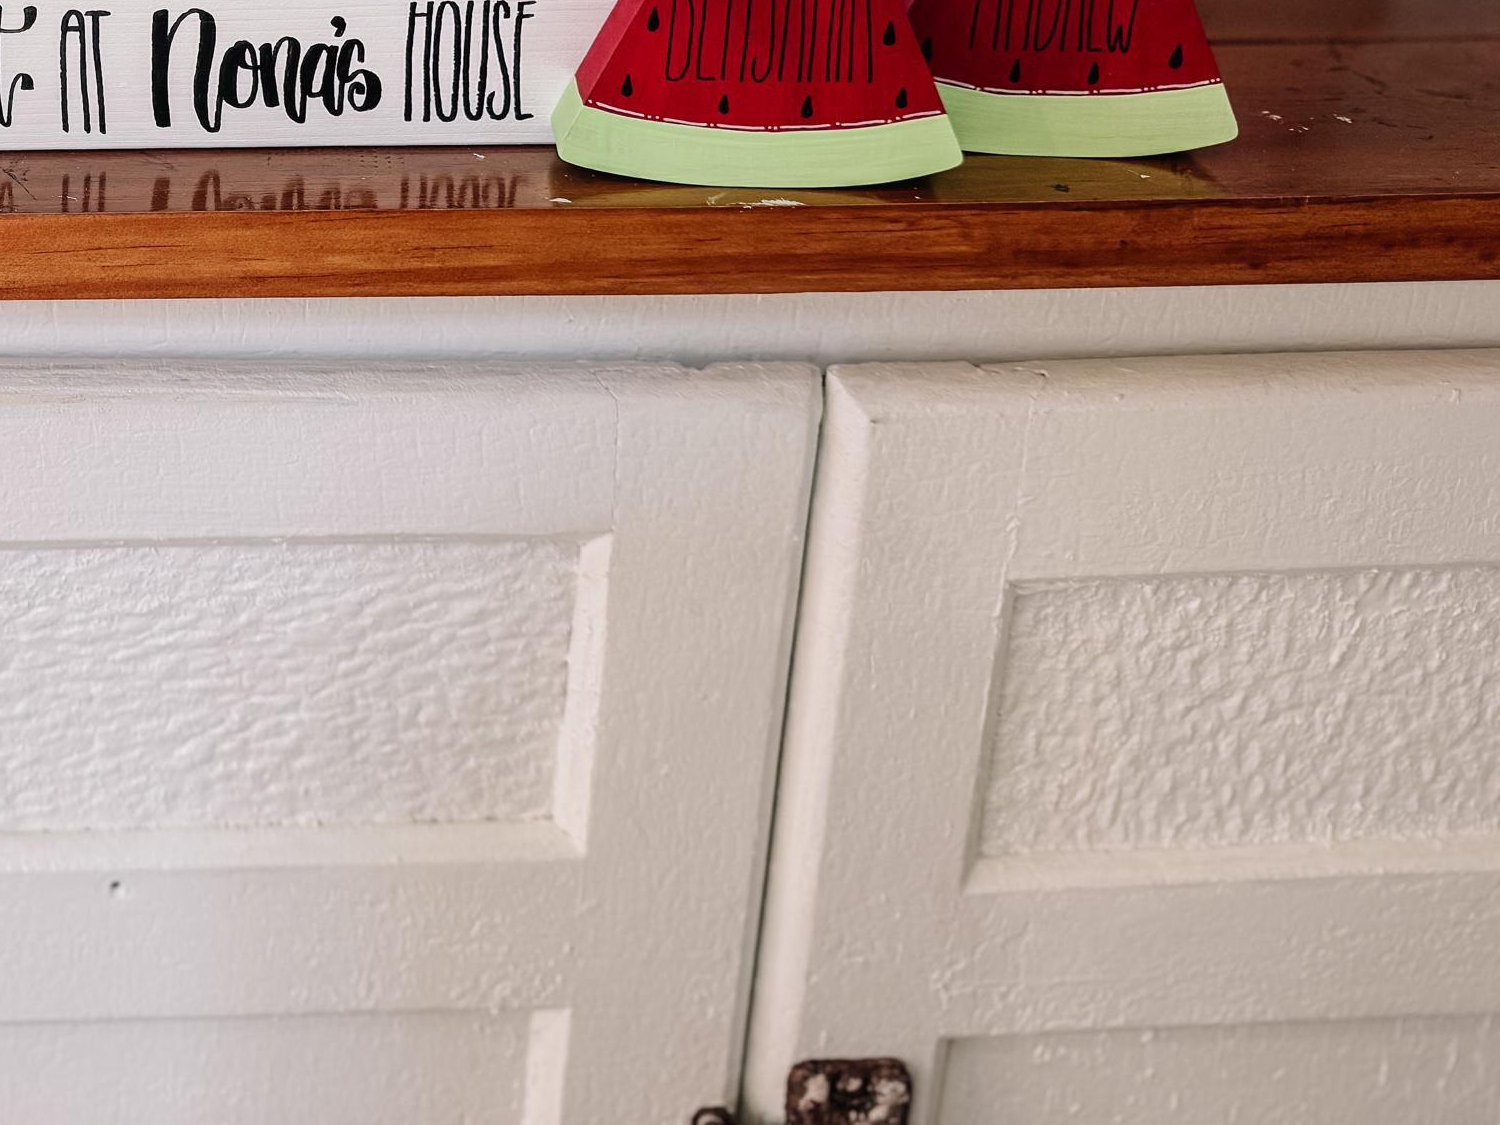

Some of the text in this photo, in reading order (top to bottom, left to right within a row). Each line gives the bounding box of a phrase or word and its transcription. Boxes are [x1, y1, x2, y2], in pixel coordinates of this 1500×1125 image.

[60, 9, 111, 134] AT
[151, 8, 382, 133] Nona's
[404, 0, 537, 122] HOUSE
